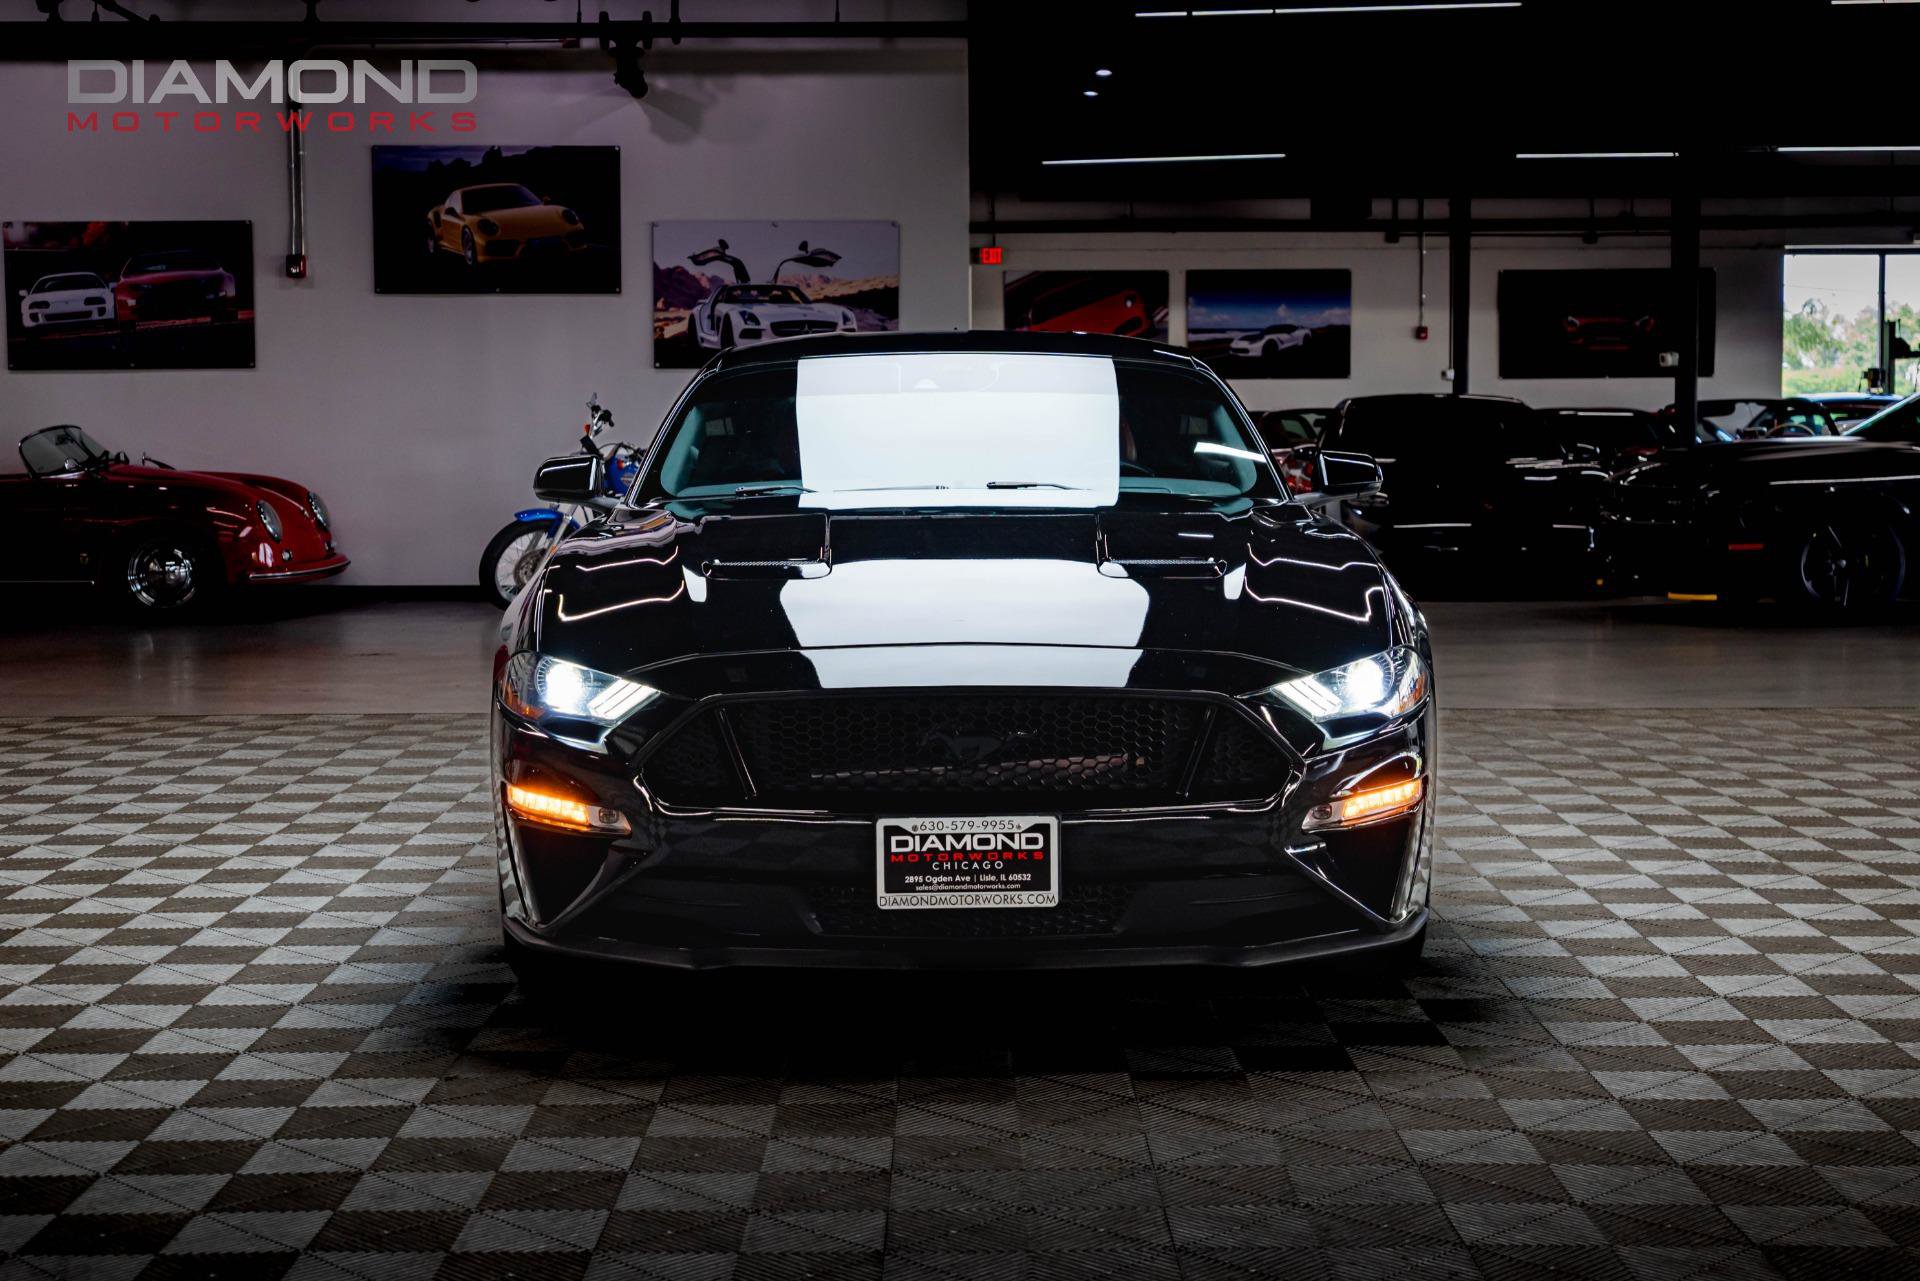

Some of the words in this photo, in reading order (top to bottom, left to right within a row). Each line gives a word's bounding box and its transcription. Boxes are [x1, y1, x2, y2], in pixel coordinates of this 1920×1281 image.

[919, 820, 1015, 831] 630-579-9955
[890, 833, 1044, 853] DIAMOND
[890, 851, 1044, 863] MOTORWORKS
[932, 860, 1004, 871] CHICAGO
[904, 876, 923, 884] 2895
[925, 875, 953, 884] Ogden
[1000, 874, 1007, 882] IL
[1008, 873, 1032, 882] 60532
[915, 882, 1021, 891] sales@diamondmotorworks.com
[879, 893, 1057, 907] DIAMONDMOTORWORKS.COM
